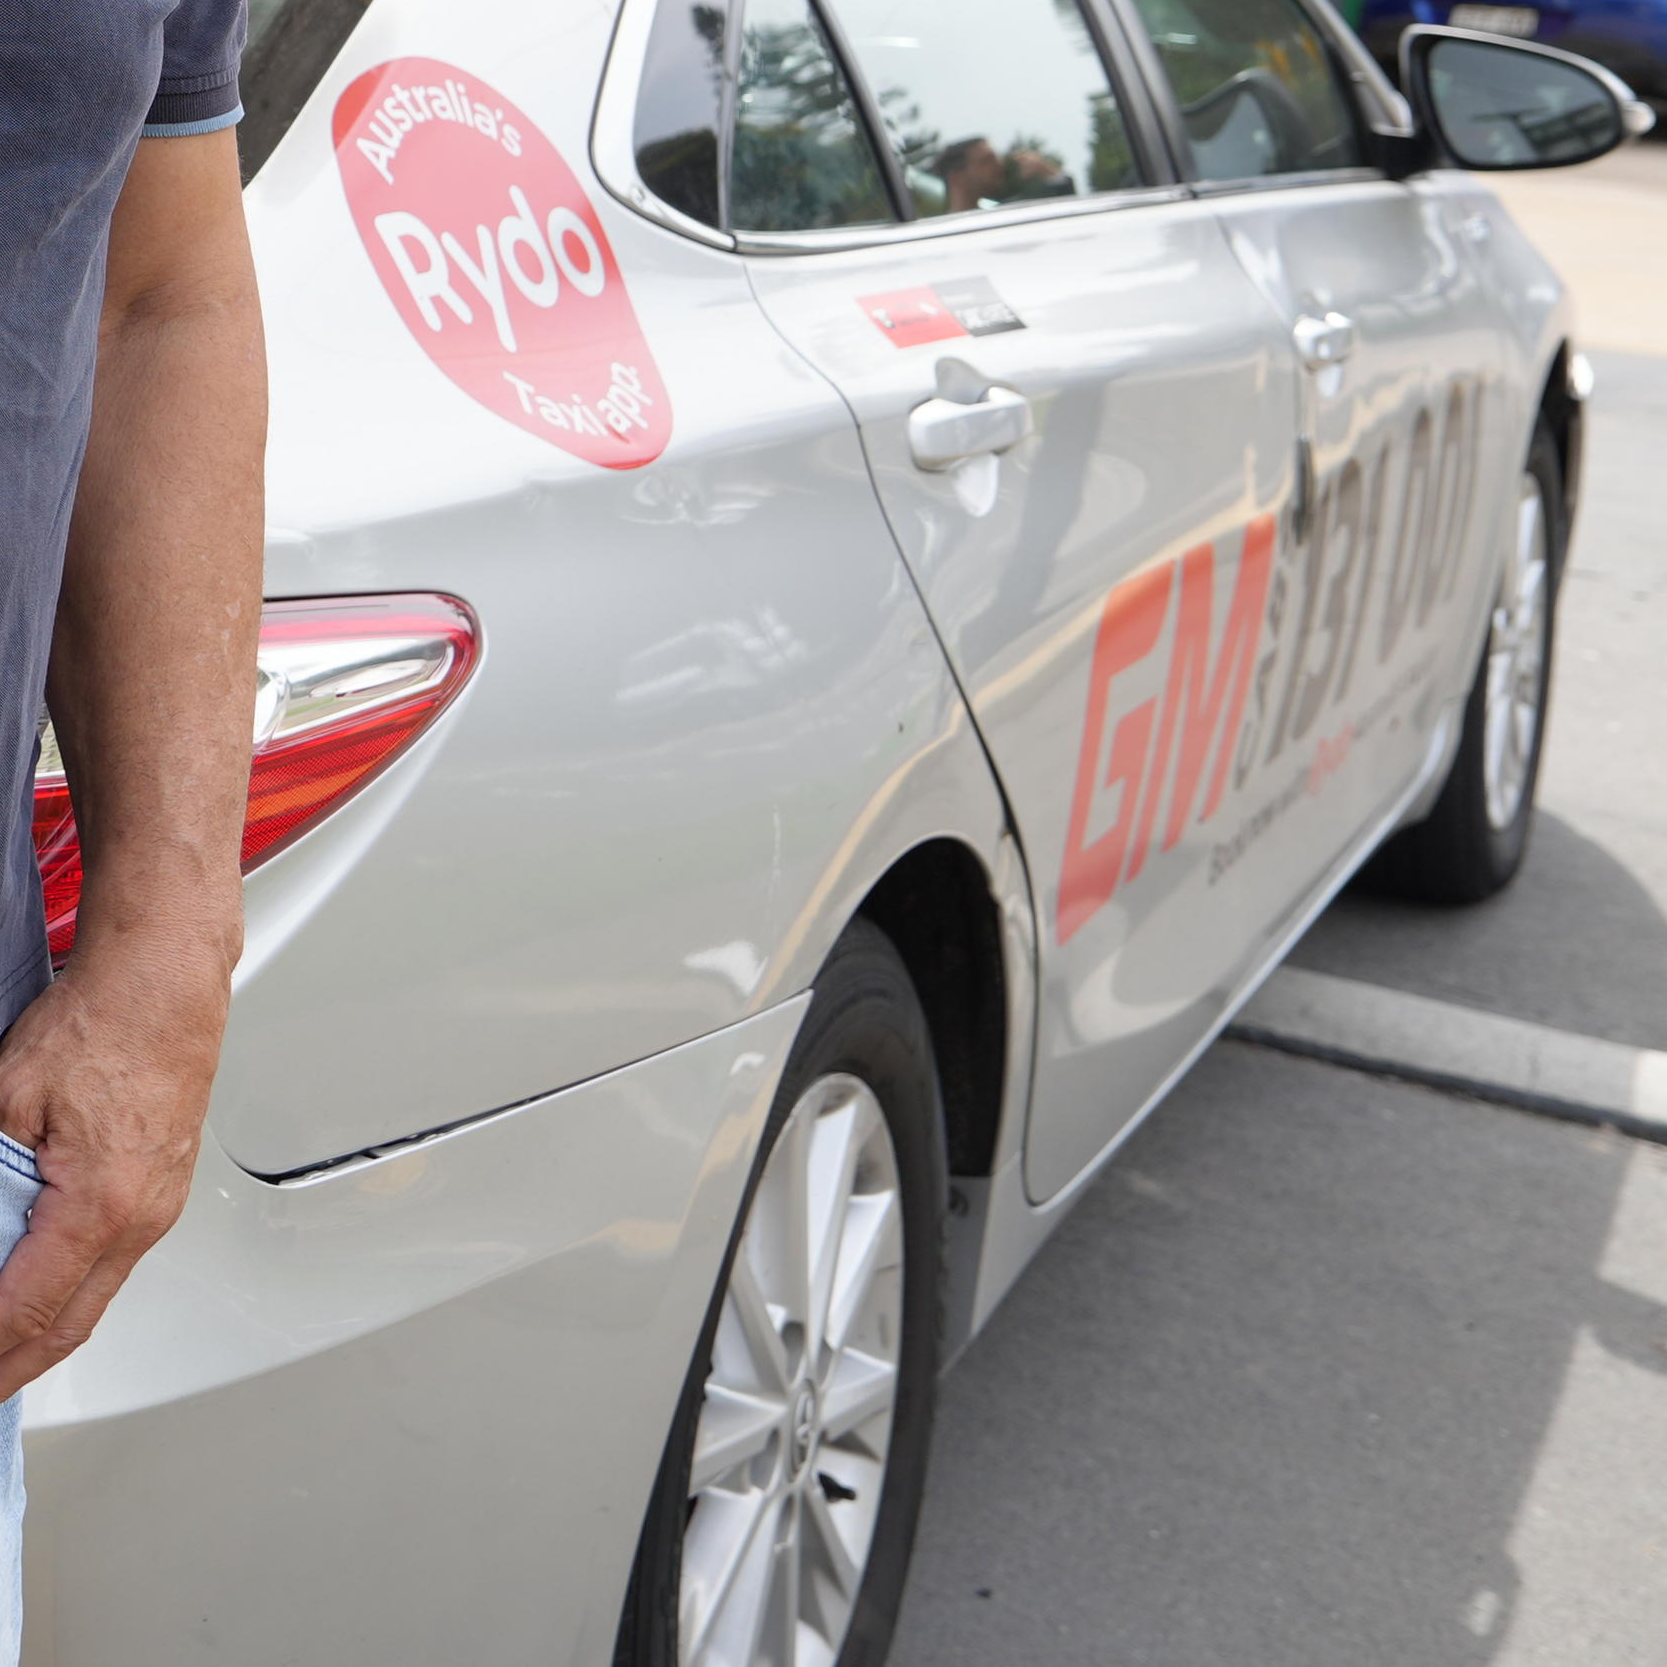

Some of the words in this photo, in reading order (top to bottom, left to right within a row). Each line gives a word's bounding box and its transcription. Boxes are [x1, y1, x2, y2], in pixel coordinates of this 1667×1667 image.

[356, 79, 523, 186] Australia's
[374, 184, 605, 353] Rydo
[503, 369, 611, 438] Taxi
[596, 361, 653, 432] app
[1056, 513, 1277, 948] GM
